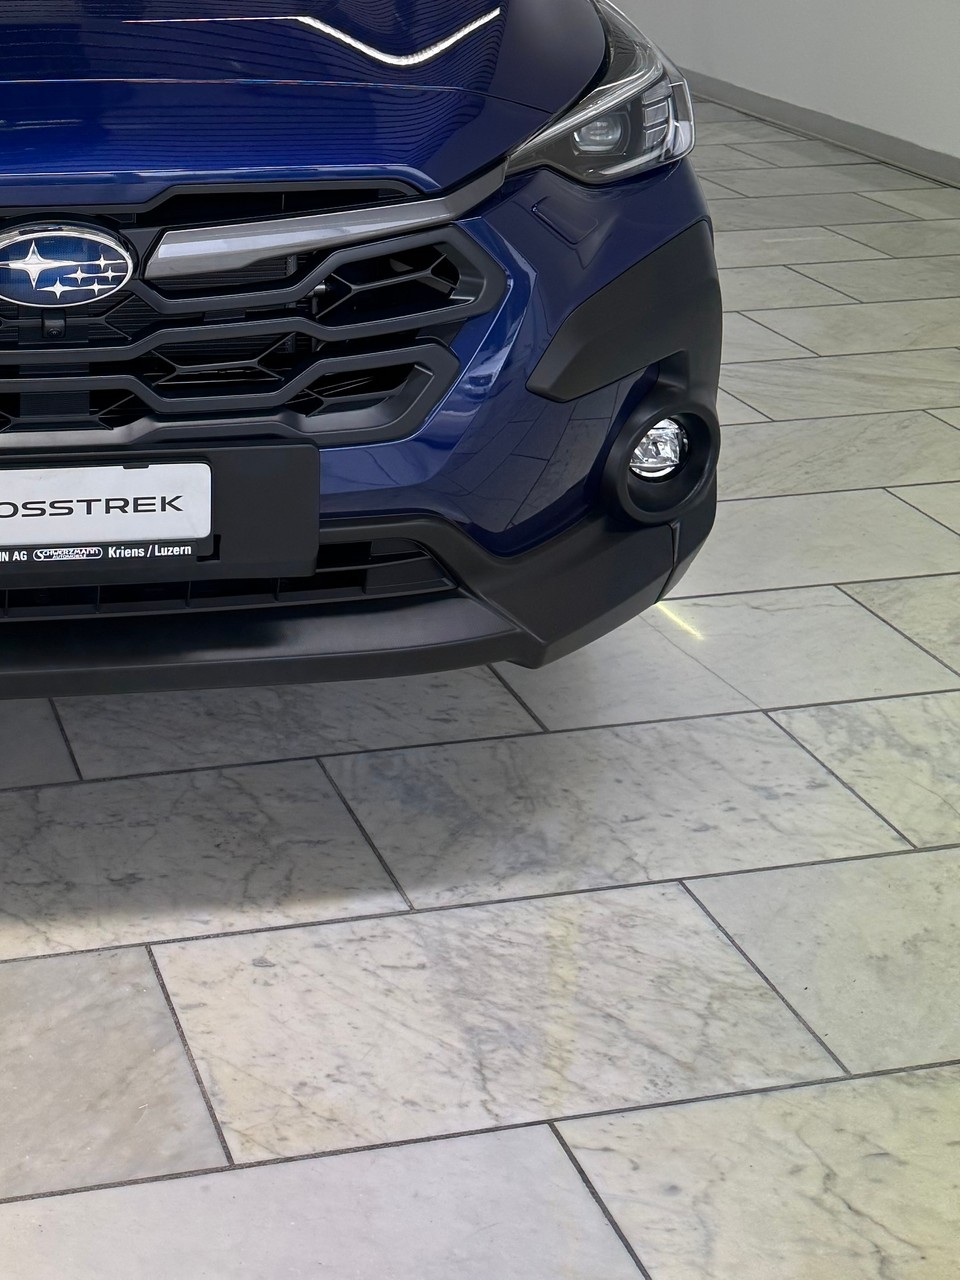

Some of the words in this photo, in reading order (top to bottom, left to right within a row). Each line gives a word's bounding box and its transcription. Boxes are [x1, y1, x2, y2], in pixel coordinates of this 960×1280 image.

[12, 550, 28, 561] AG
[108, 546, 145, 558] Kriens
[154, 545, 192, 556] Luzern
